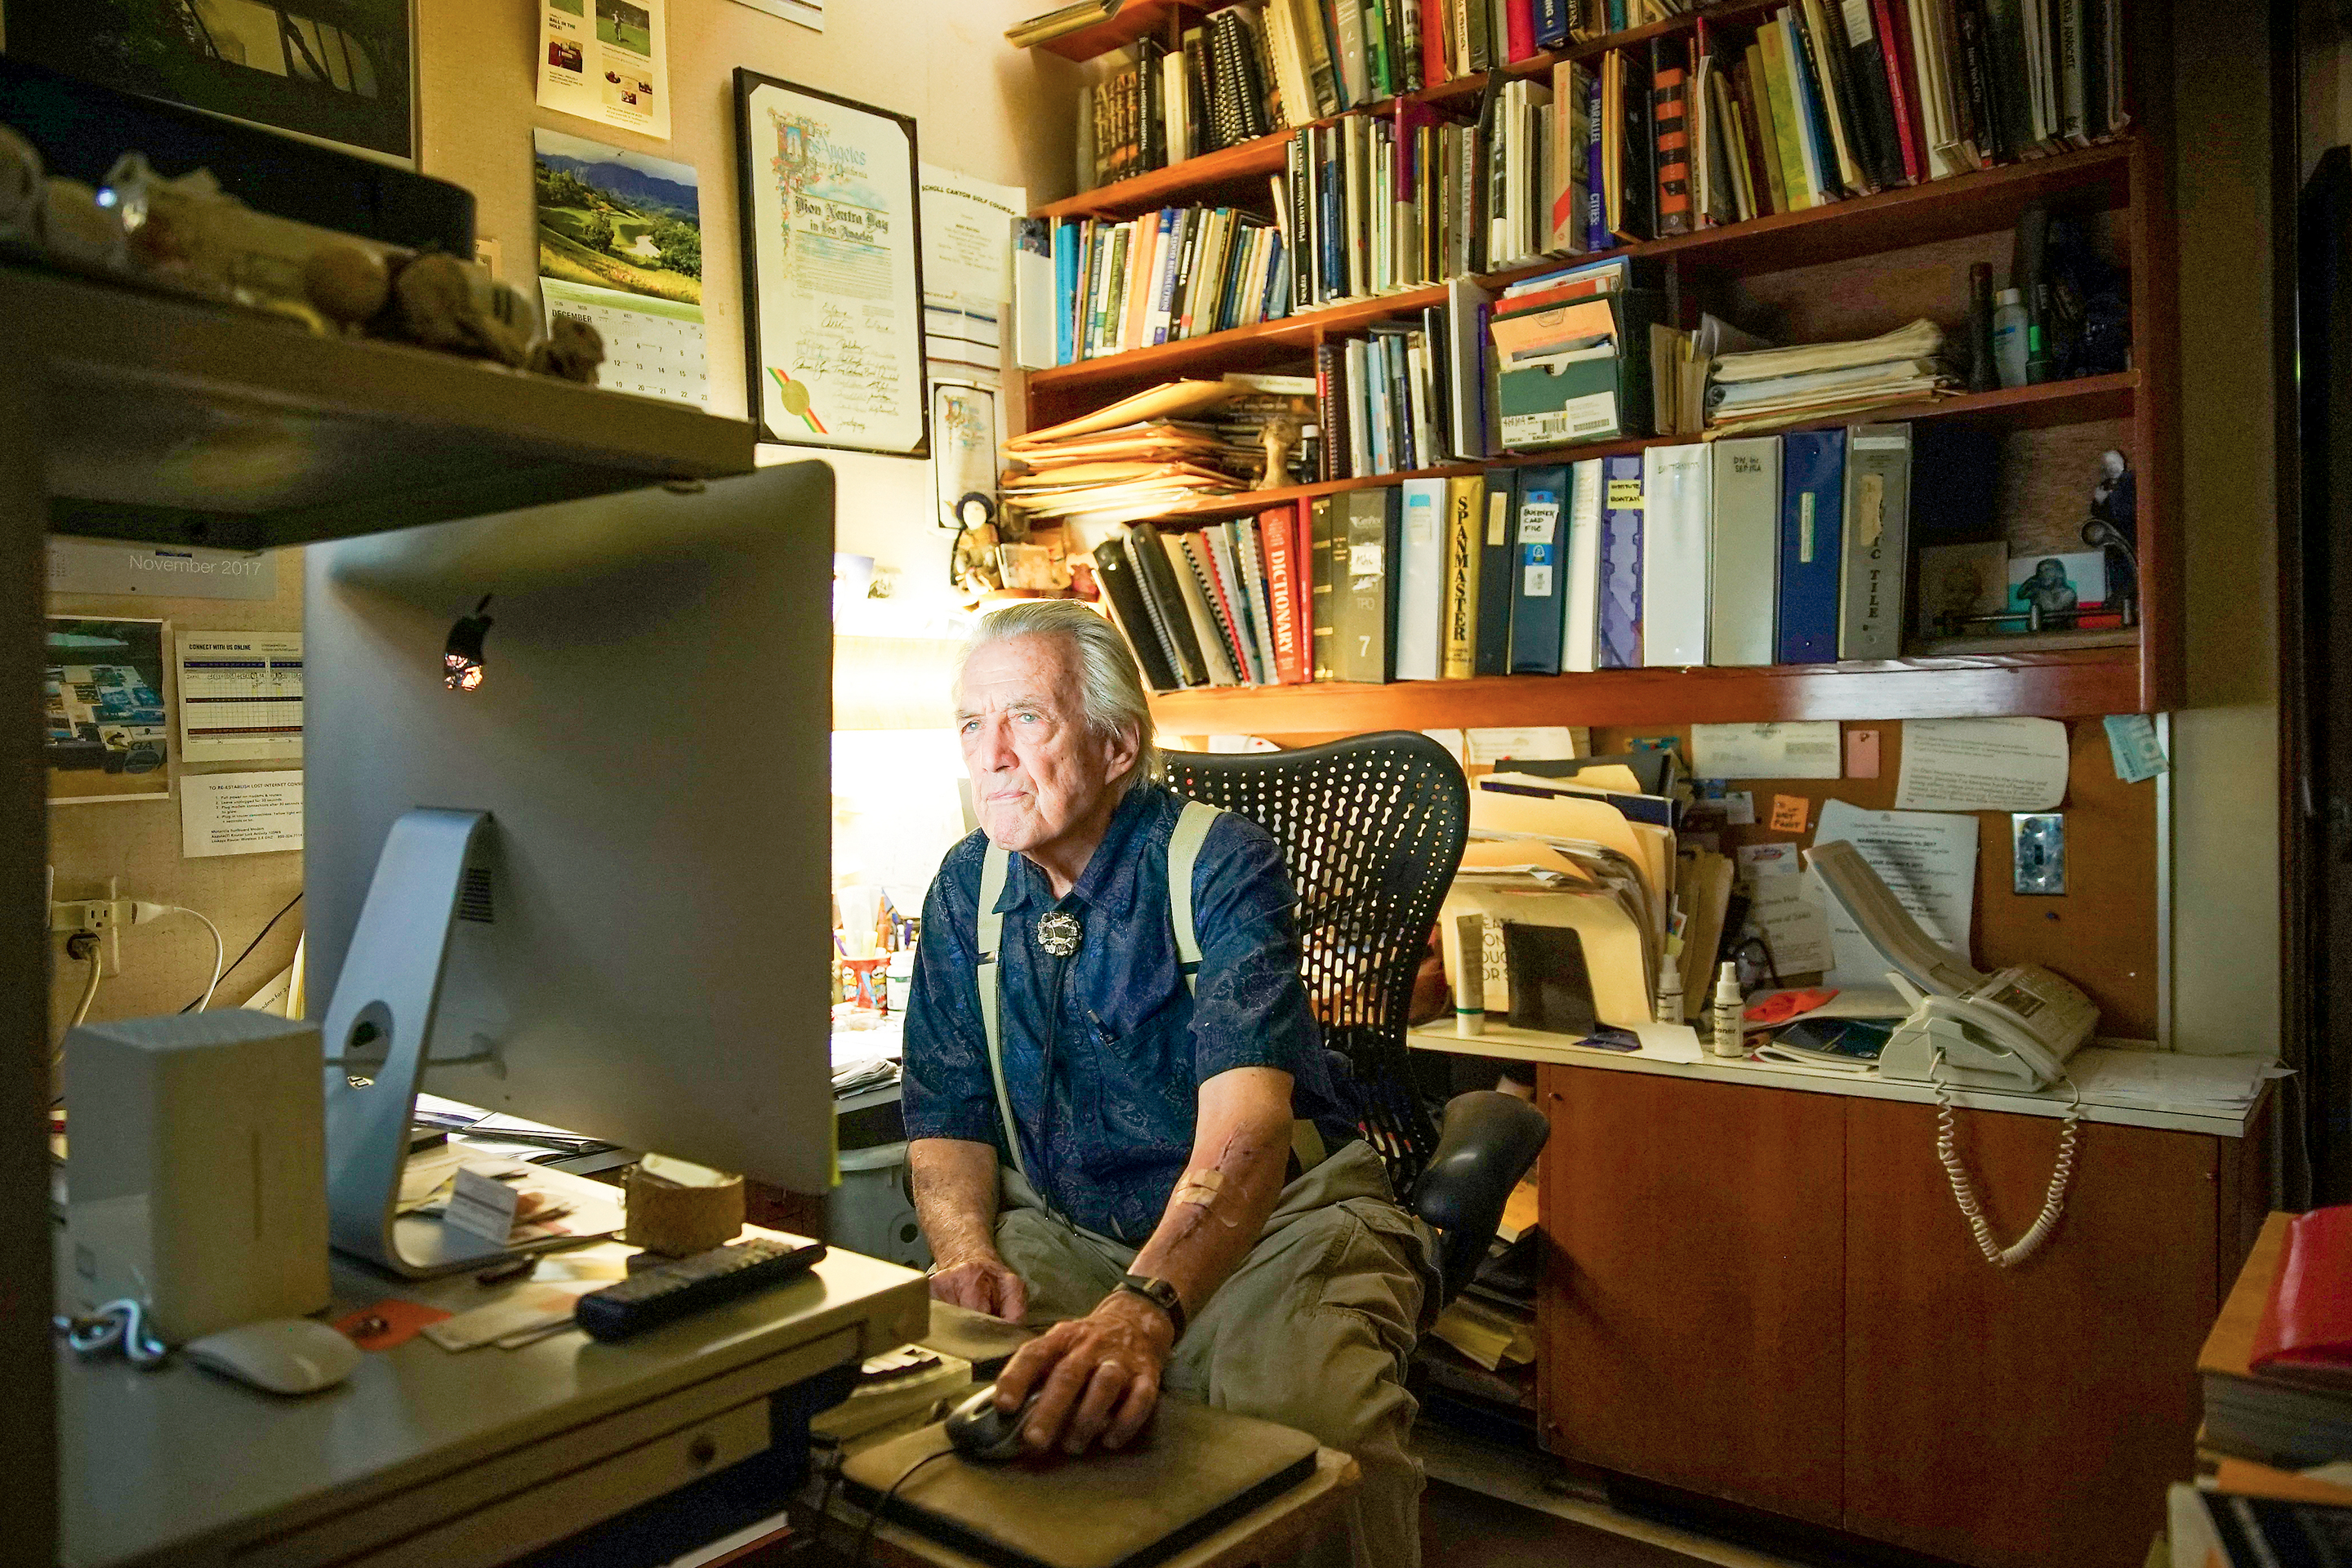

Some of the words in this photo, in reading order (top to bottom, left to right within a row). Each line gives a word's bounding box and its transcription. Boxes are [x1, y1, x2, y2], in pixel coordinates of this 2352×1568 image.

[130, 555, 216, 573] November
[221, 560, 261, 576] 2017
[1454, 497, 1468, 641] SPANMASTER
[1271, 550, 1294, 654] DICTIONARY
[1868, 569, 1881, 618] TILE
[1358, 635, 1371, 657] 7
